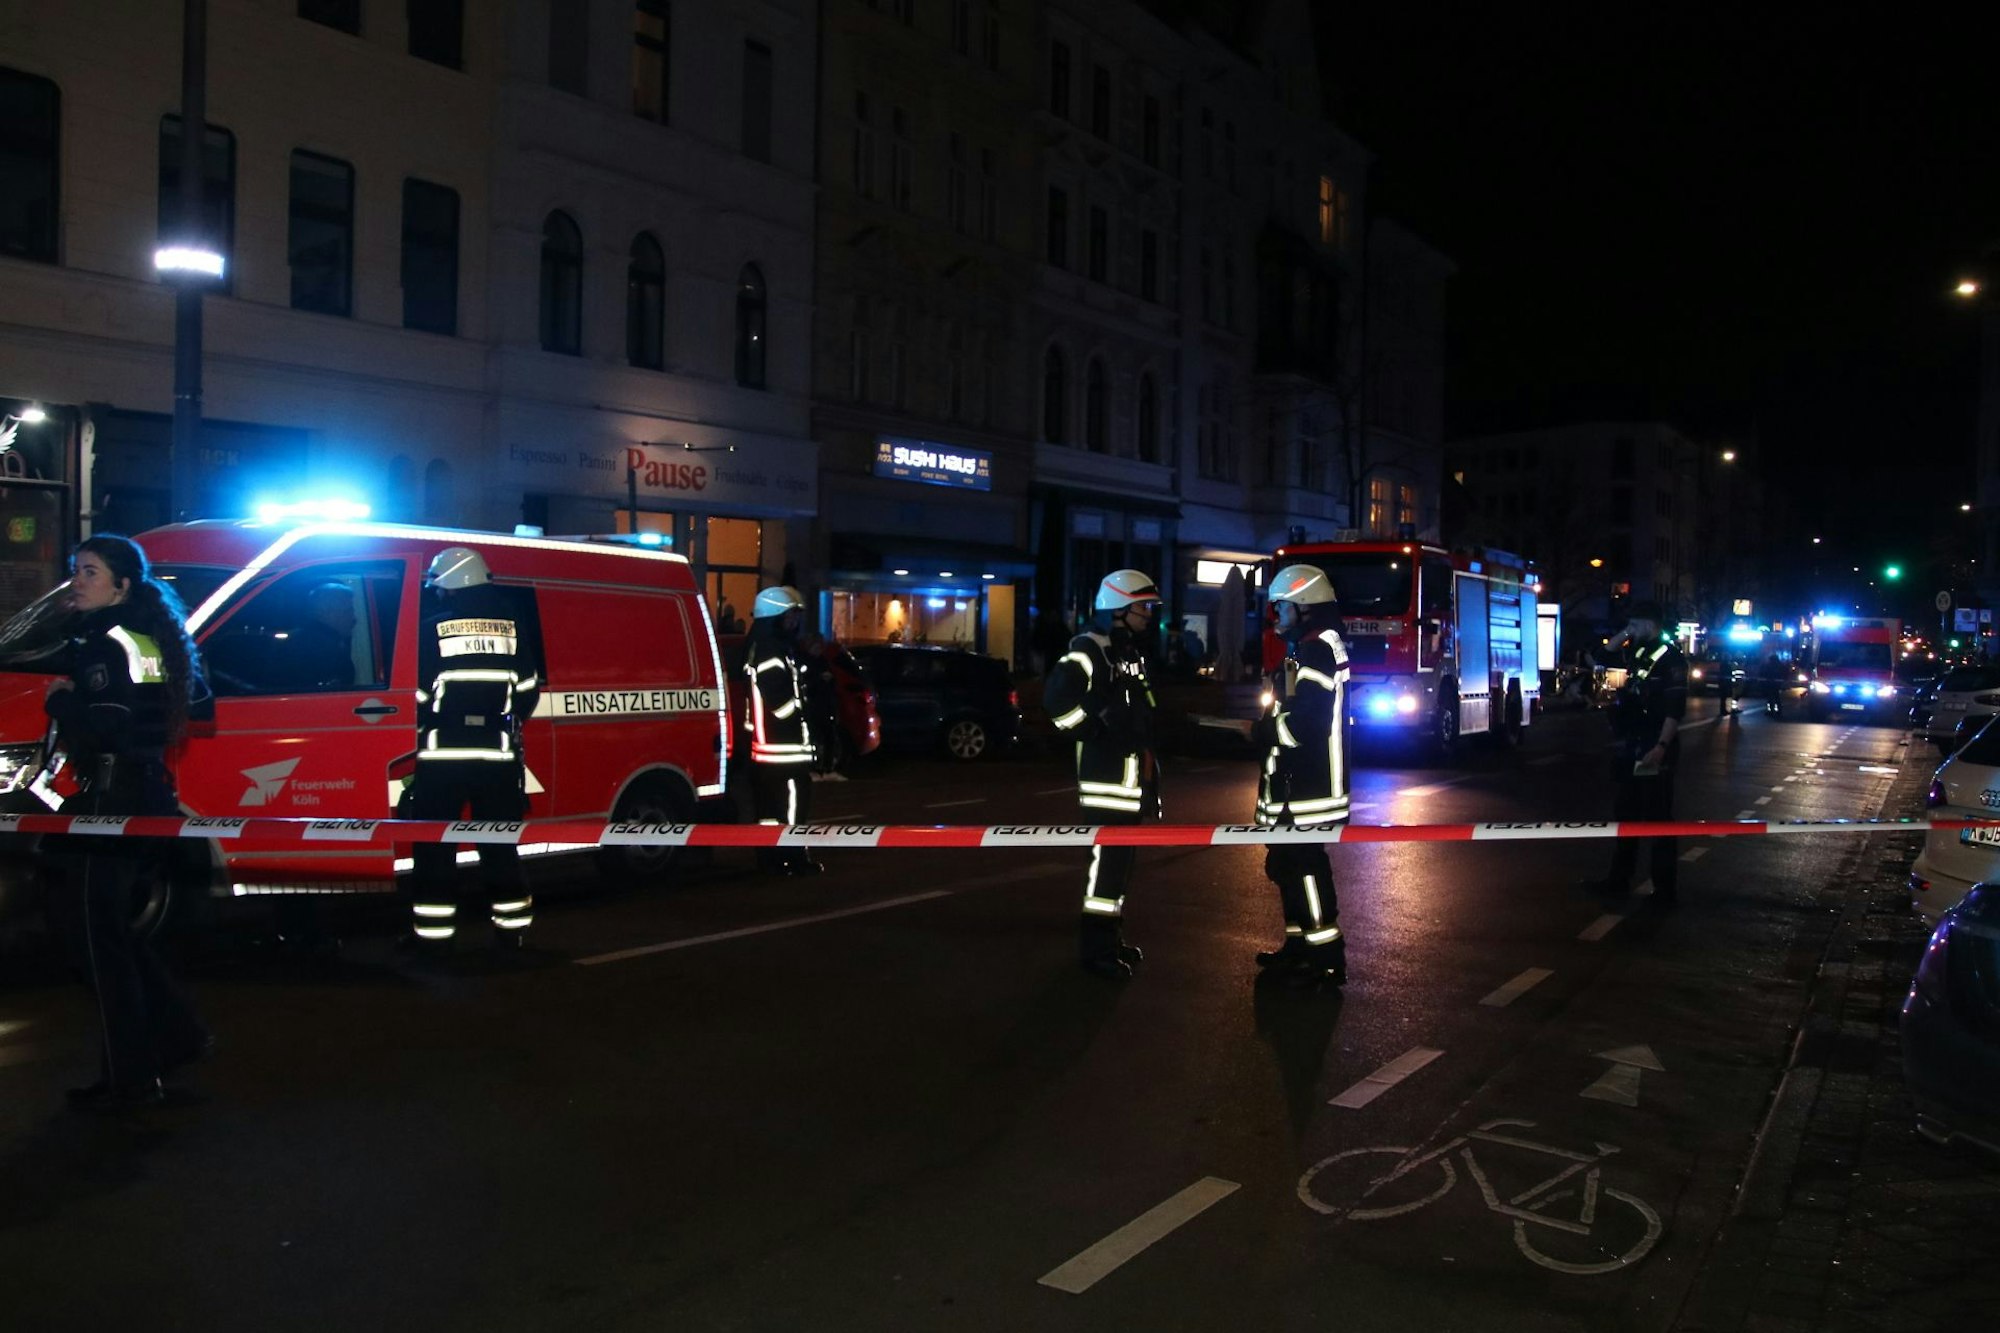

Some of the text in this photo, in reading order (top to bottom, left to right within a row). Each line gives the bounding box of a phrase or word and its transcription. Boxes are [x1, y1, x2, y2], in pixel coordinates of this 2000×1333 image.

[510, 443, 568, 466] Espresso
[579, 452, 616, 471] Panini
[624, 448, 706, 490] Pause
[893, 447, 938, 469] SUSHI
[564, 691, 710, 713] EINSATZLEITUNG
[291, 778, 356, 790] Feuerwehr
[291, 794, 321, 805] Köln
